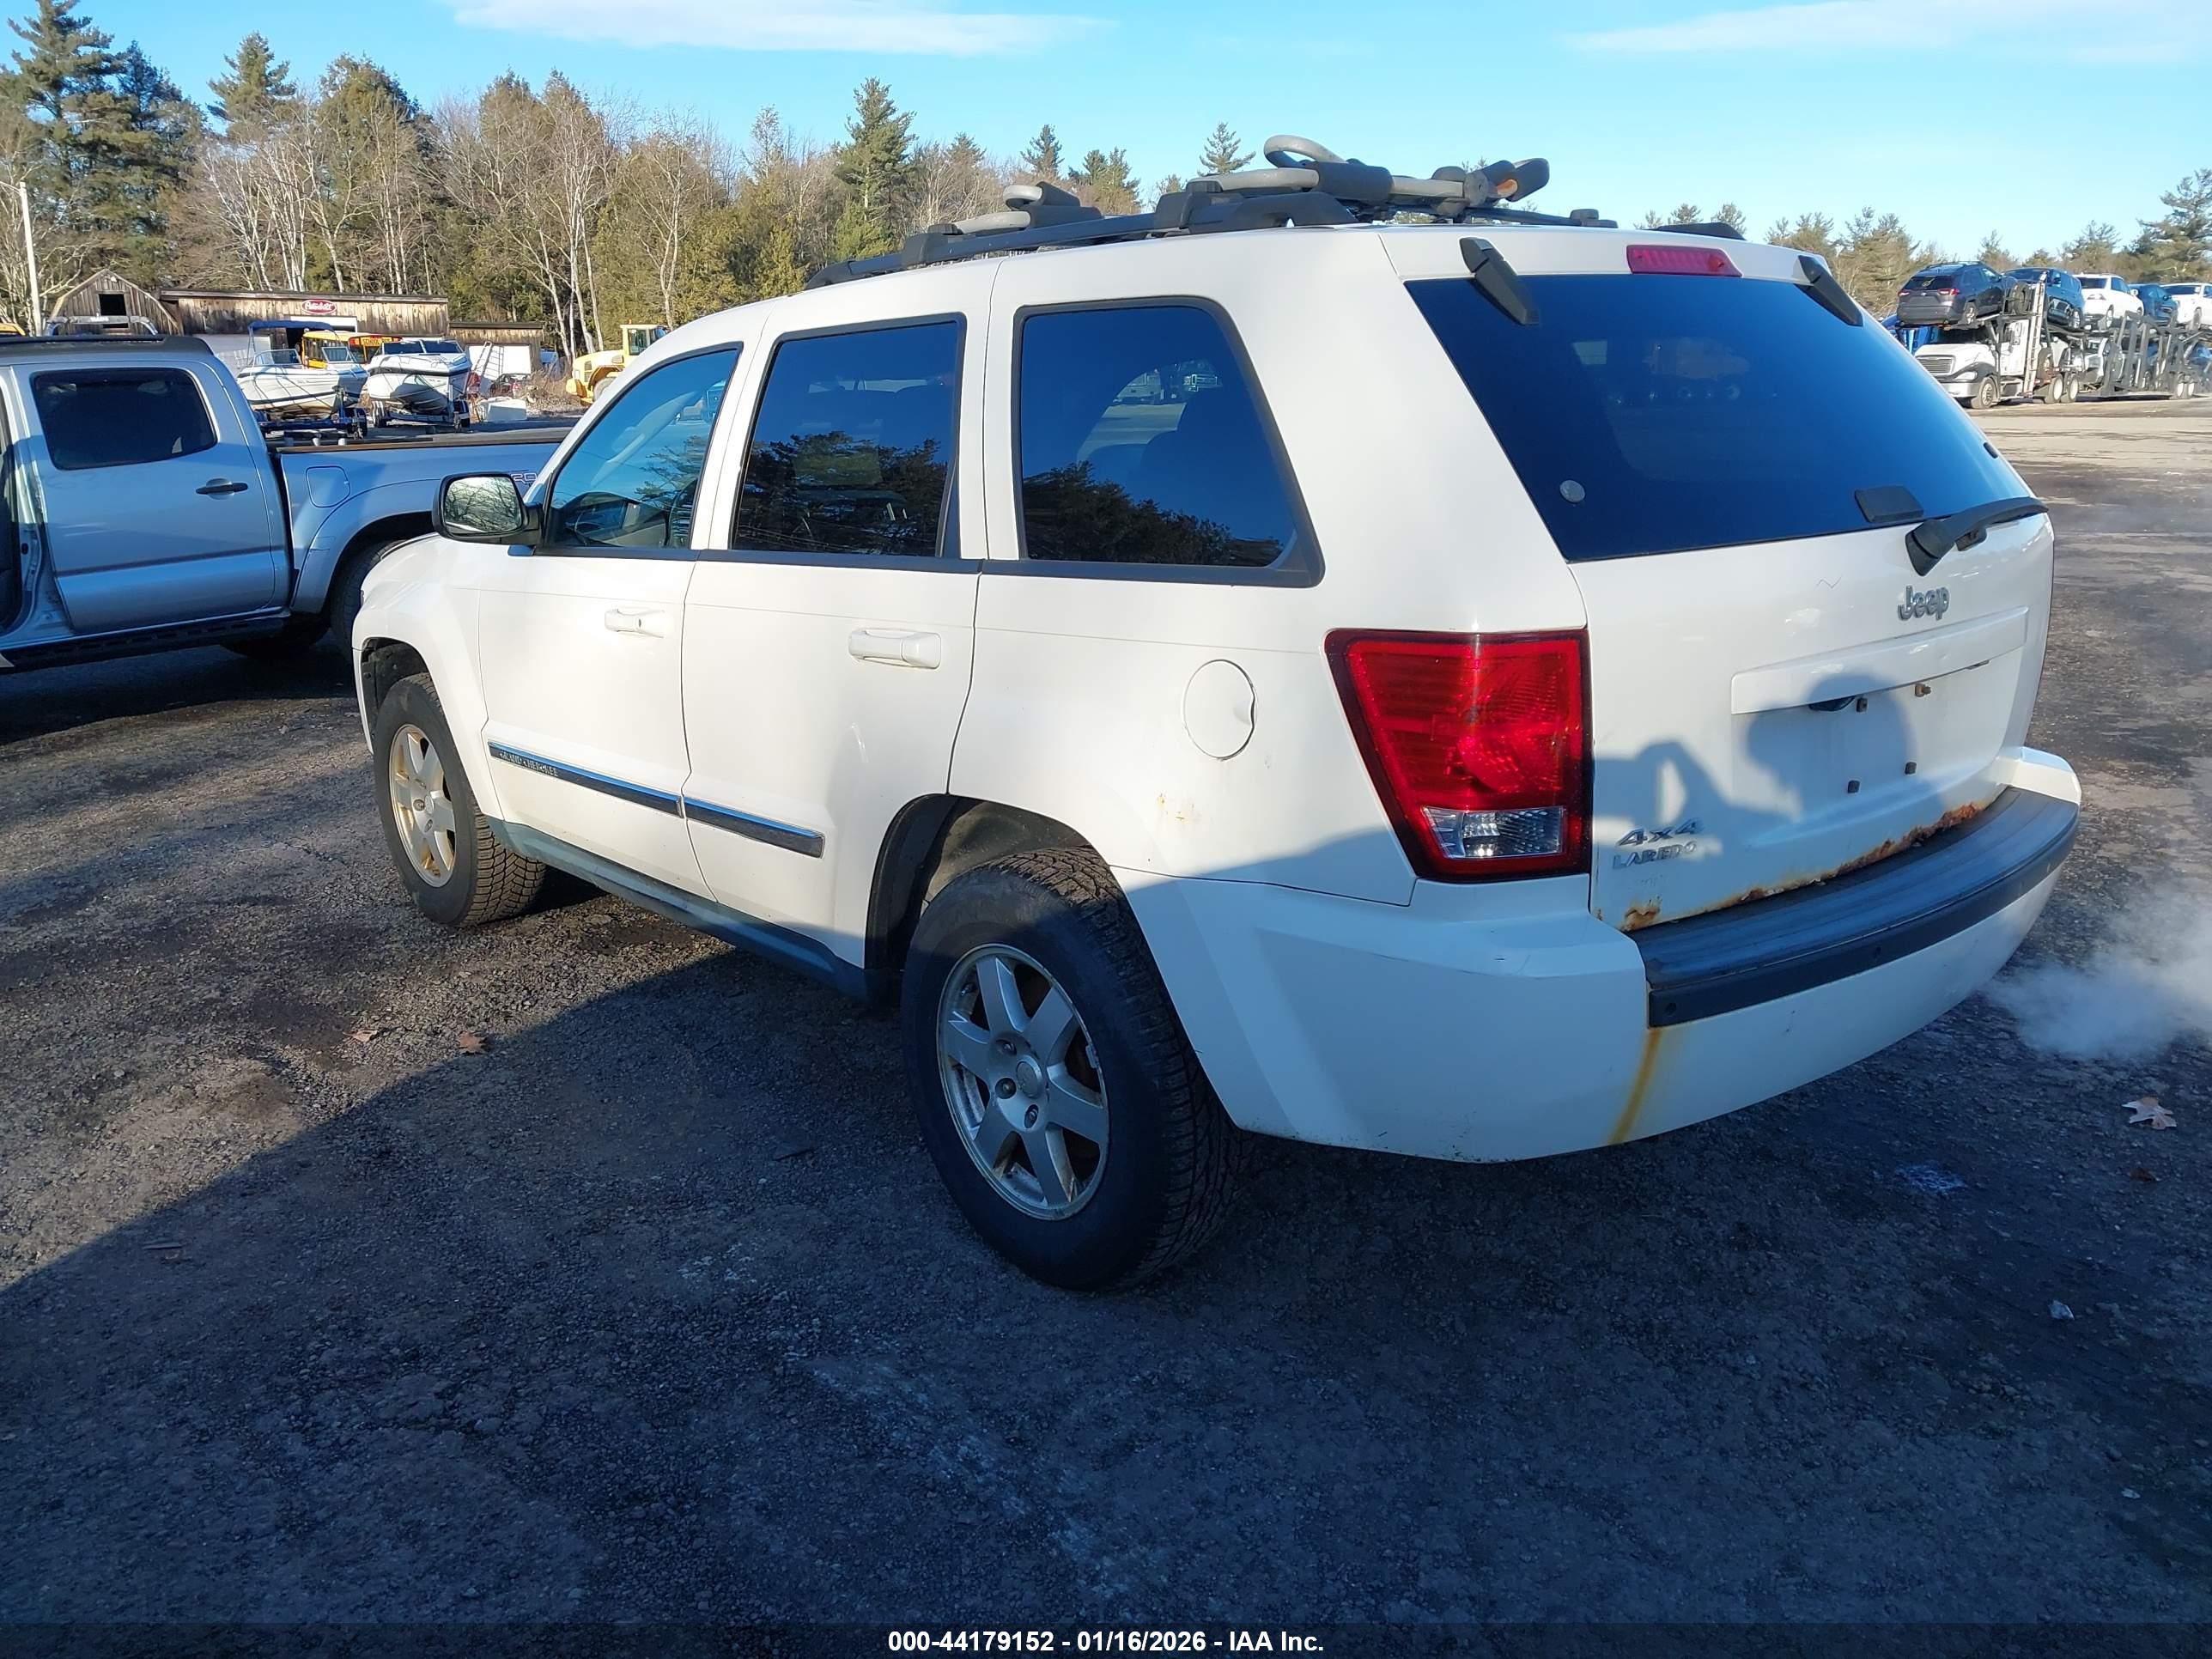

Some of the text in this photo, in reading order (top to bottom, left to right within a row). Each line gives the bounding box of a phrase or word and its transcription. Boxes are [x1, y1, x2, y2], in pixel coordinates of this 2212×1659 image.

[511, 472, 538, 484] RD
[1897, 585, 1950, 621] Jeep
[523, 760, 558, 776] CHEROKEE
[1616, 817, 1702, 846] 4x4
[1613, 841, 1697, 870] LAREDO
